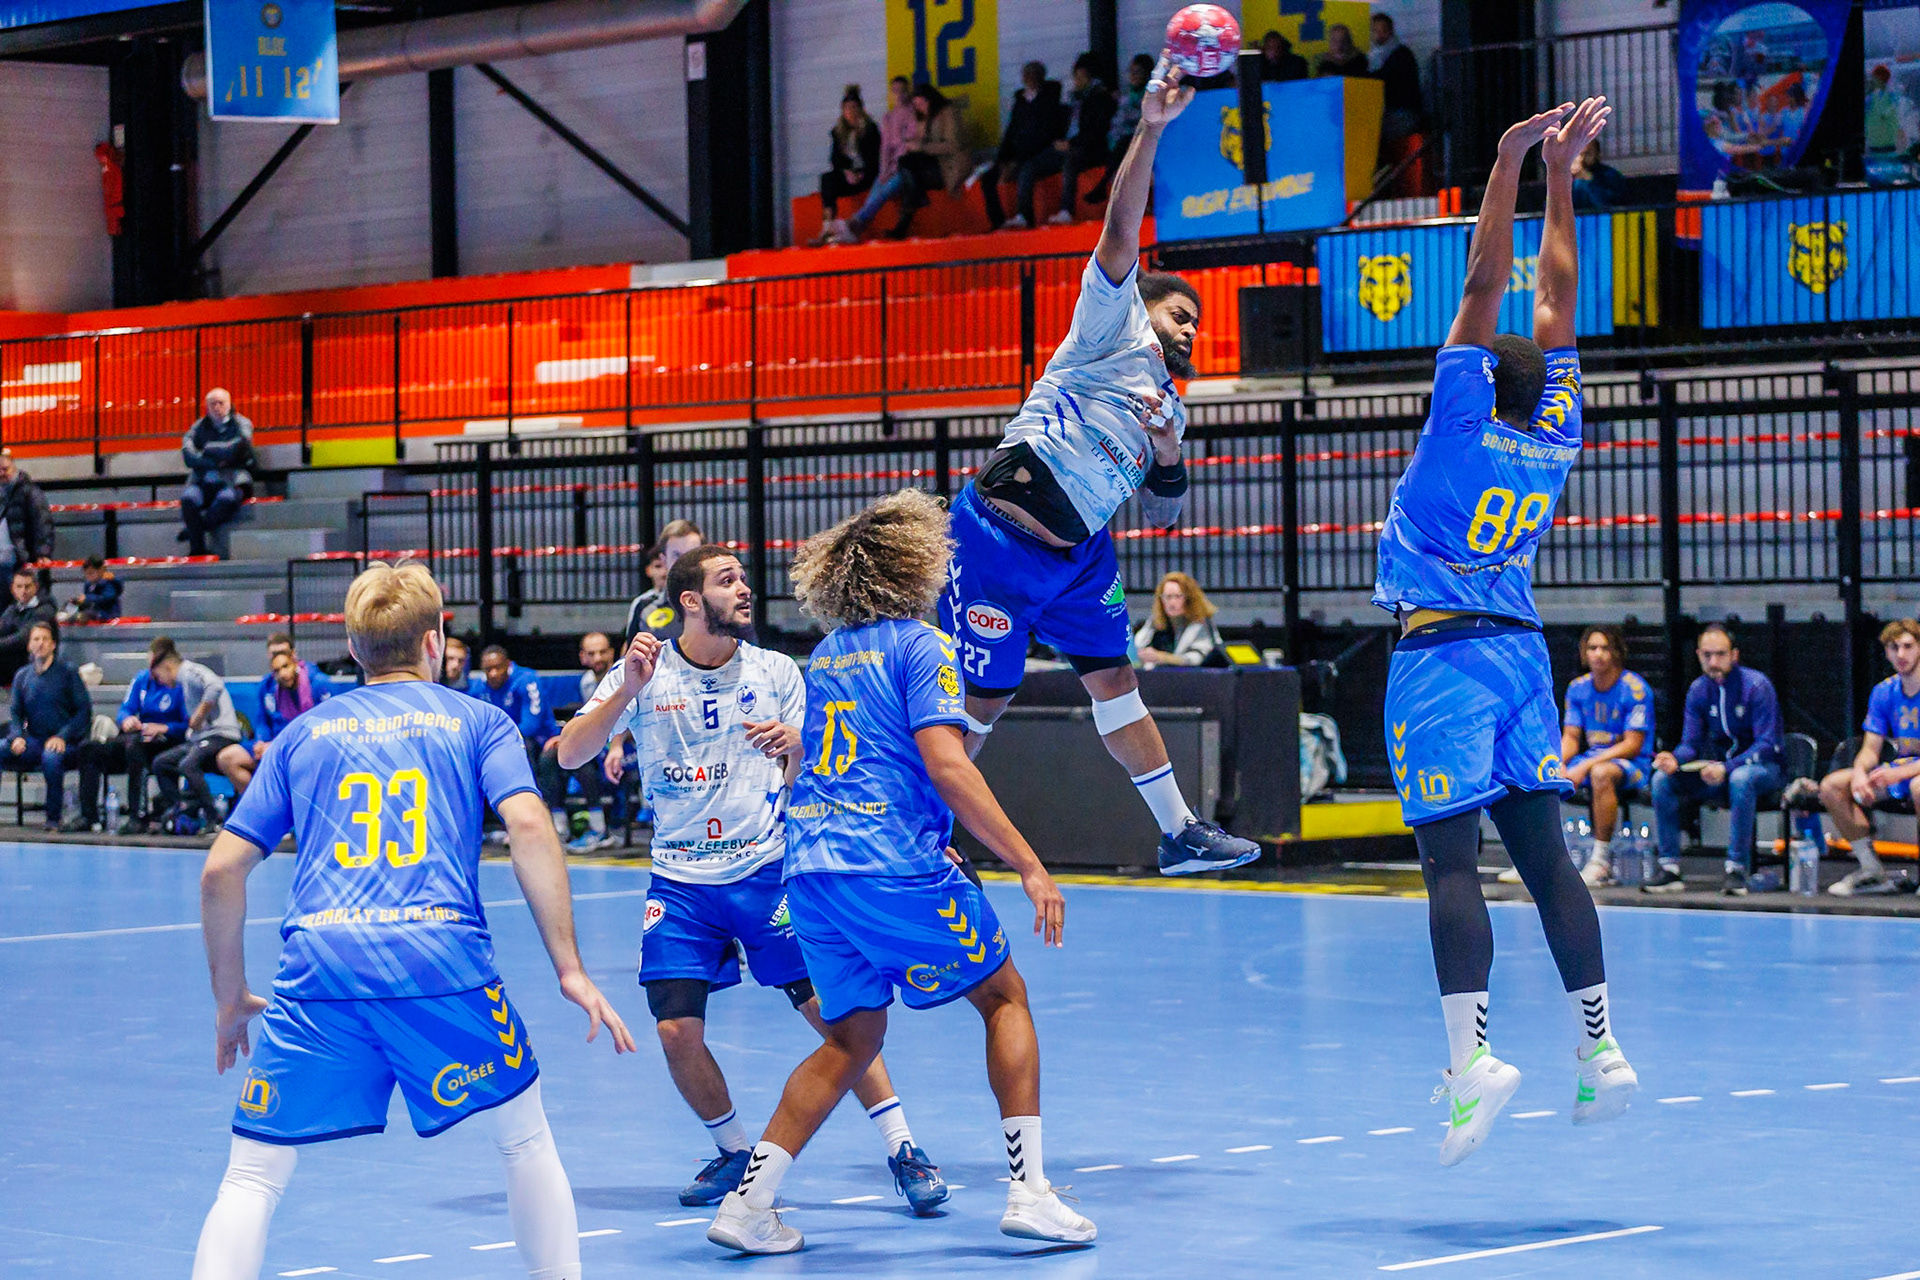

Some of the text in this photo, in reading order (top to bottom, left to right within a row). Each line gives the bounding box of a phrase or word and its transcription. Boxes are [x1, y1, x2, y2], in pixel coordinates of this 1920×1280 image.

[907, 0, 977, 87] 12
[284, 67, 310, 98] 12
[967, 610, 1010, 631] cora
[963, 641, 991, 678] 27
[655, 703, 686, 712] Aurore
[702, 699, 720, 730] 5
[813, 700, 858, 776] 15
[663, 763, 729, 783] SOCATEB
[1418, 769, 1449, 795] in
[334, 767, 428, 869] 33
[299, 906, 461, 928] TREMBLAY EN FRANCE
[241, 1067, 270, 1105] in
